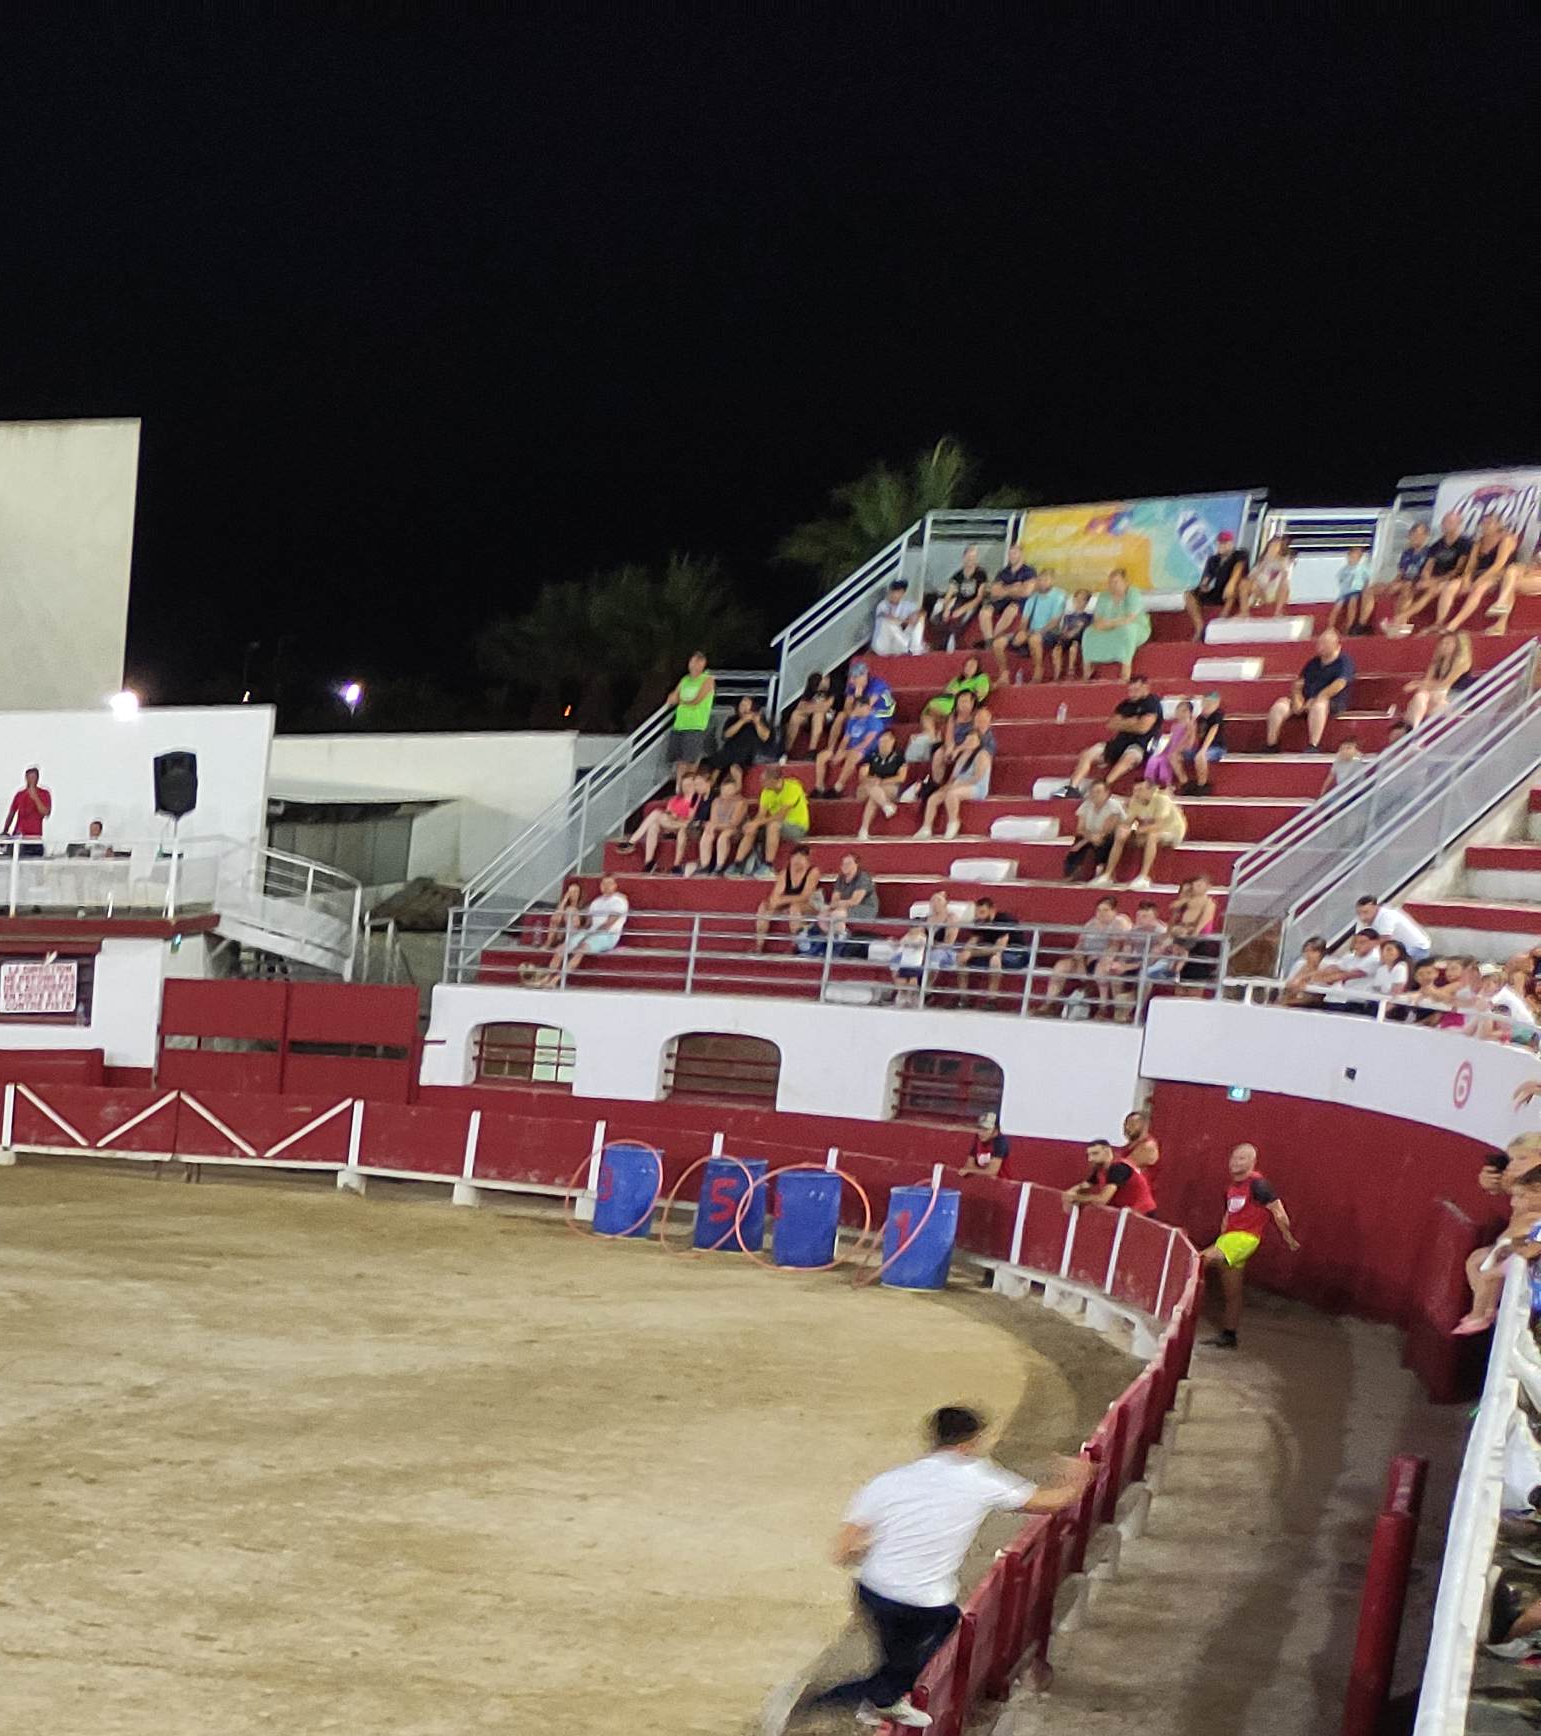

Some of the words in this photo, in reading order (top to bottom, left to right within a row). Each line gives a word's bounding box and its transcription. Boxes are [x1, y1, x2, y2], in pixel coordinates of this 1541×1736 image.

[1457, 1067, 1469, 1101] 6
[709, 1178, 739, 1223] 5
[894, 1209, 912, 1250] 1
